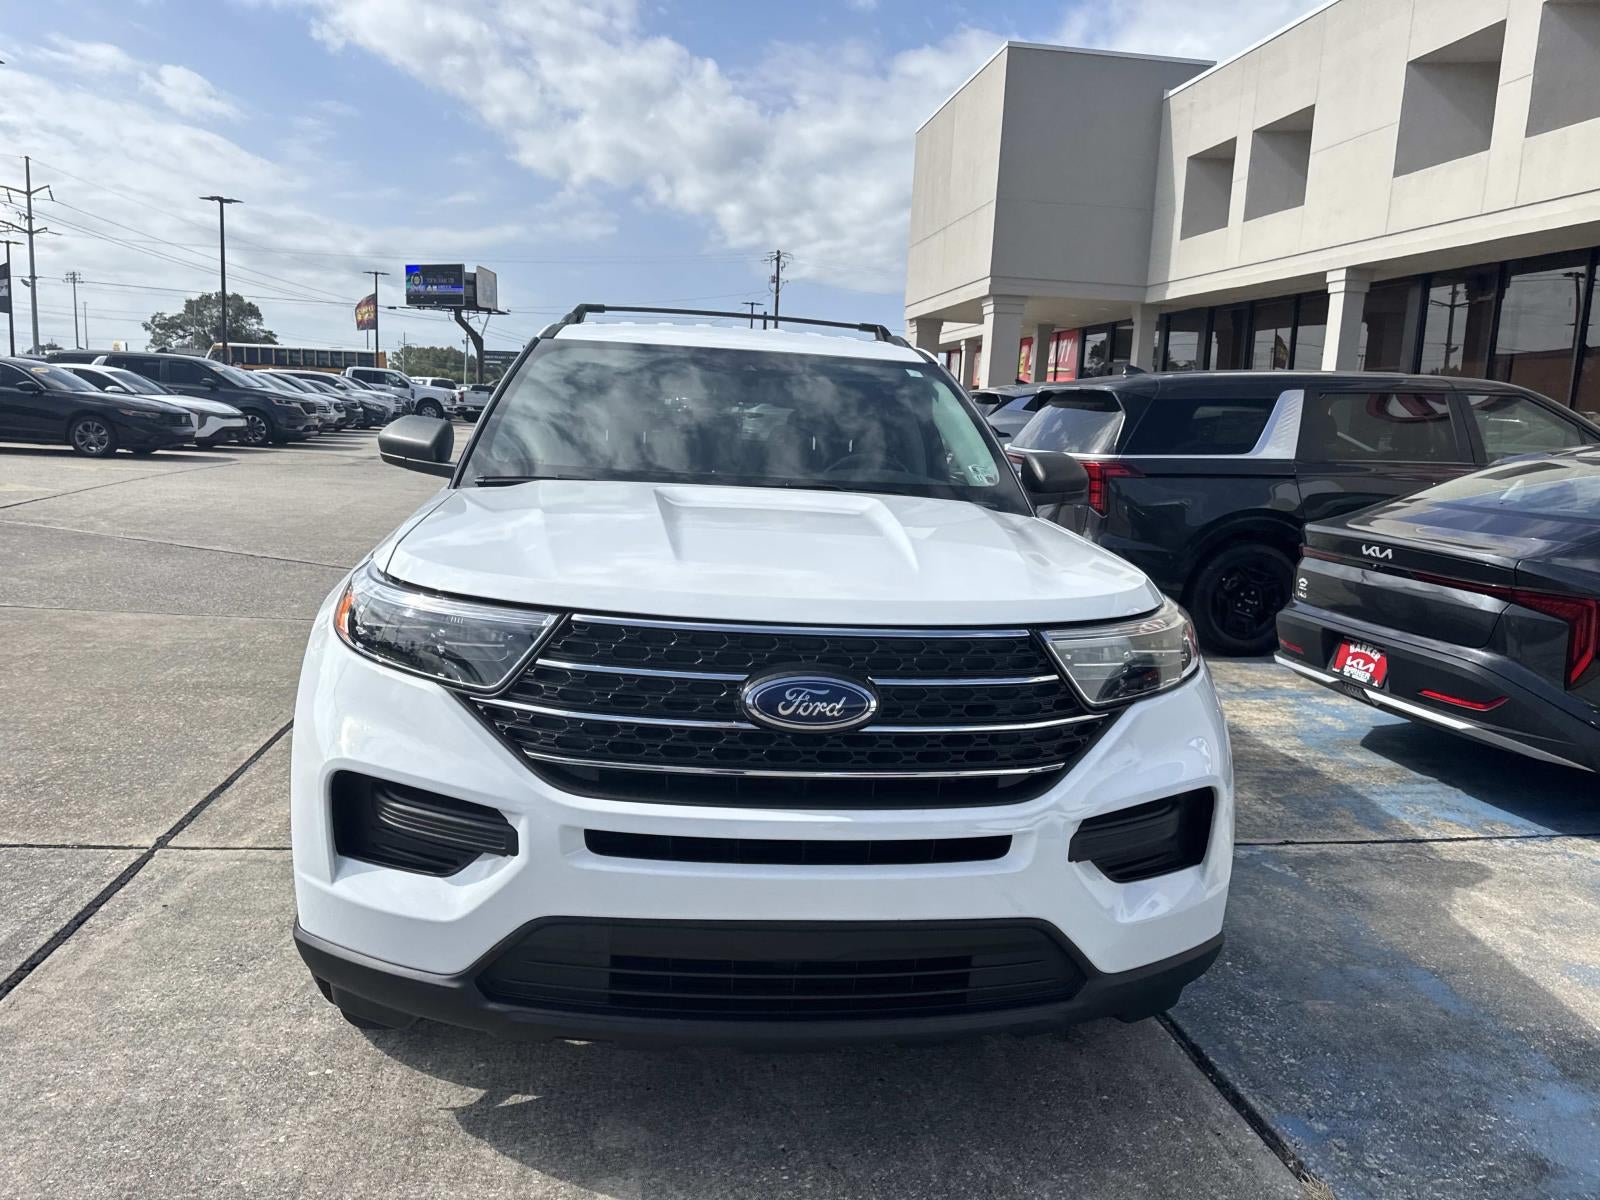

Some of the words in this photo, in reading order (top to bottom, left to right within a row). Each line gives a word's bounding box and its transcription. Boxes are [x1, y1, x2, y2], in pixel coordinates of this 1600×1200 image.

[1361, 544, 1393, 560] KIA
[1349, 643, 1381, 662] BARKER
[1345, 655, 1376, 673] KIA
[777, 687, 846, 717] Ford
